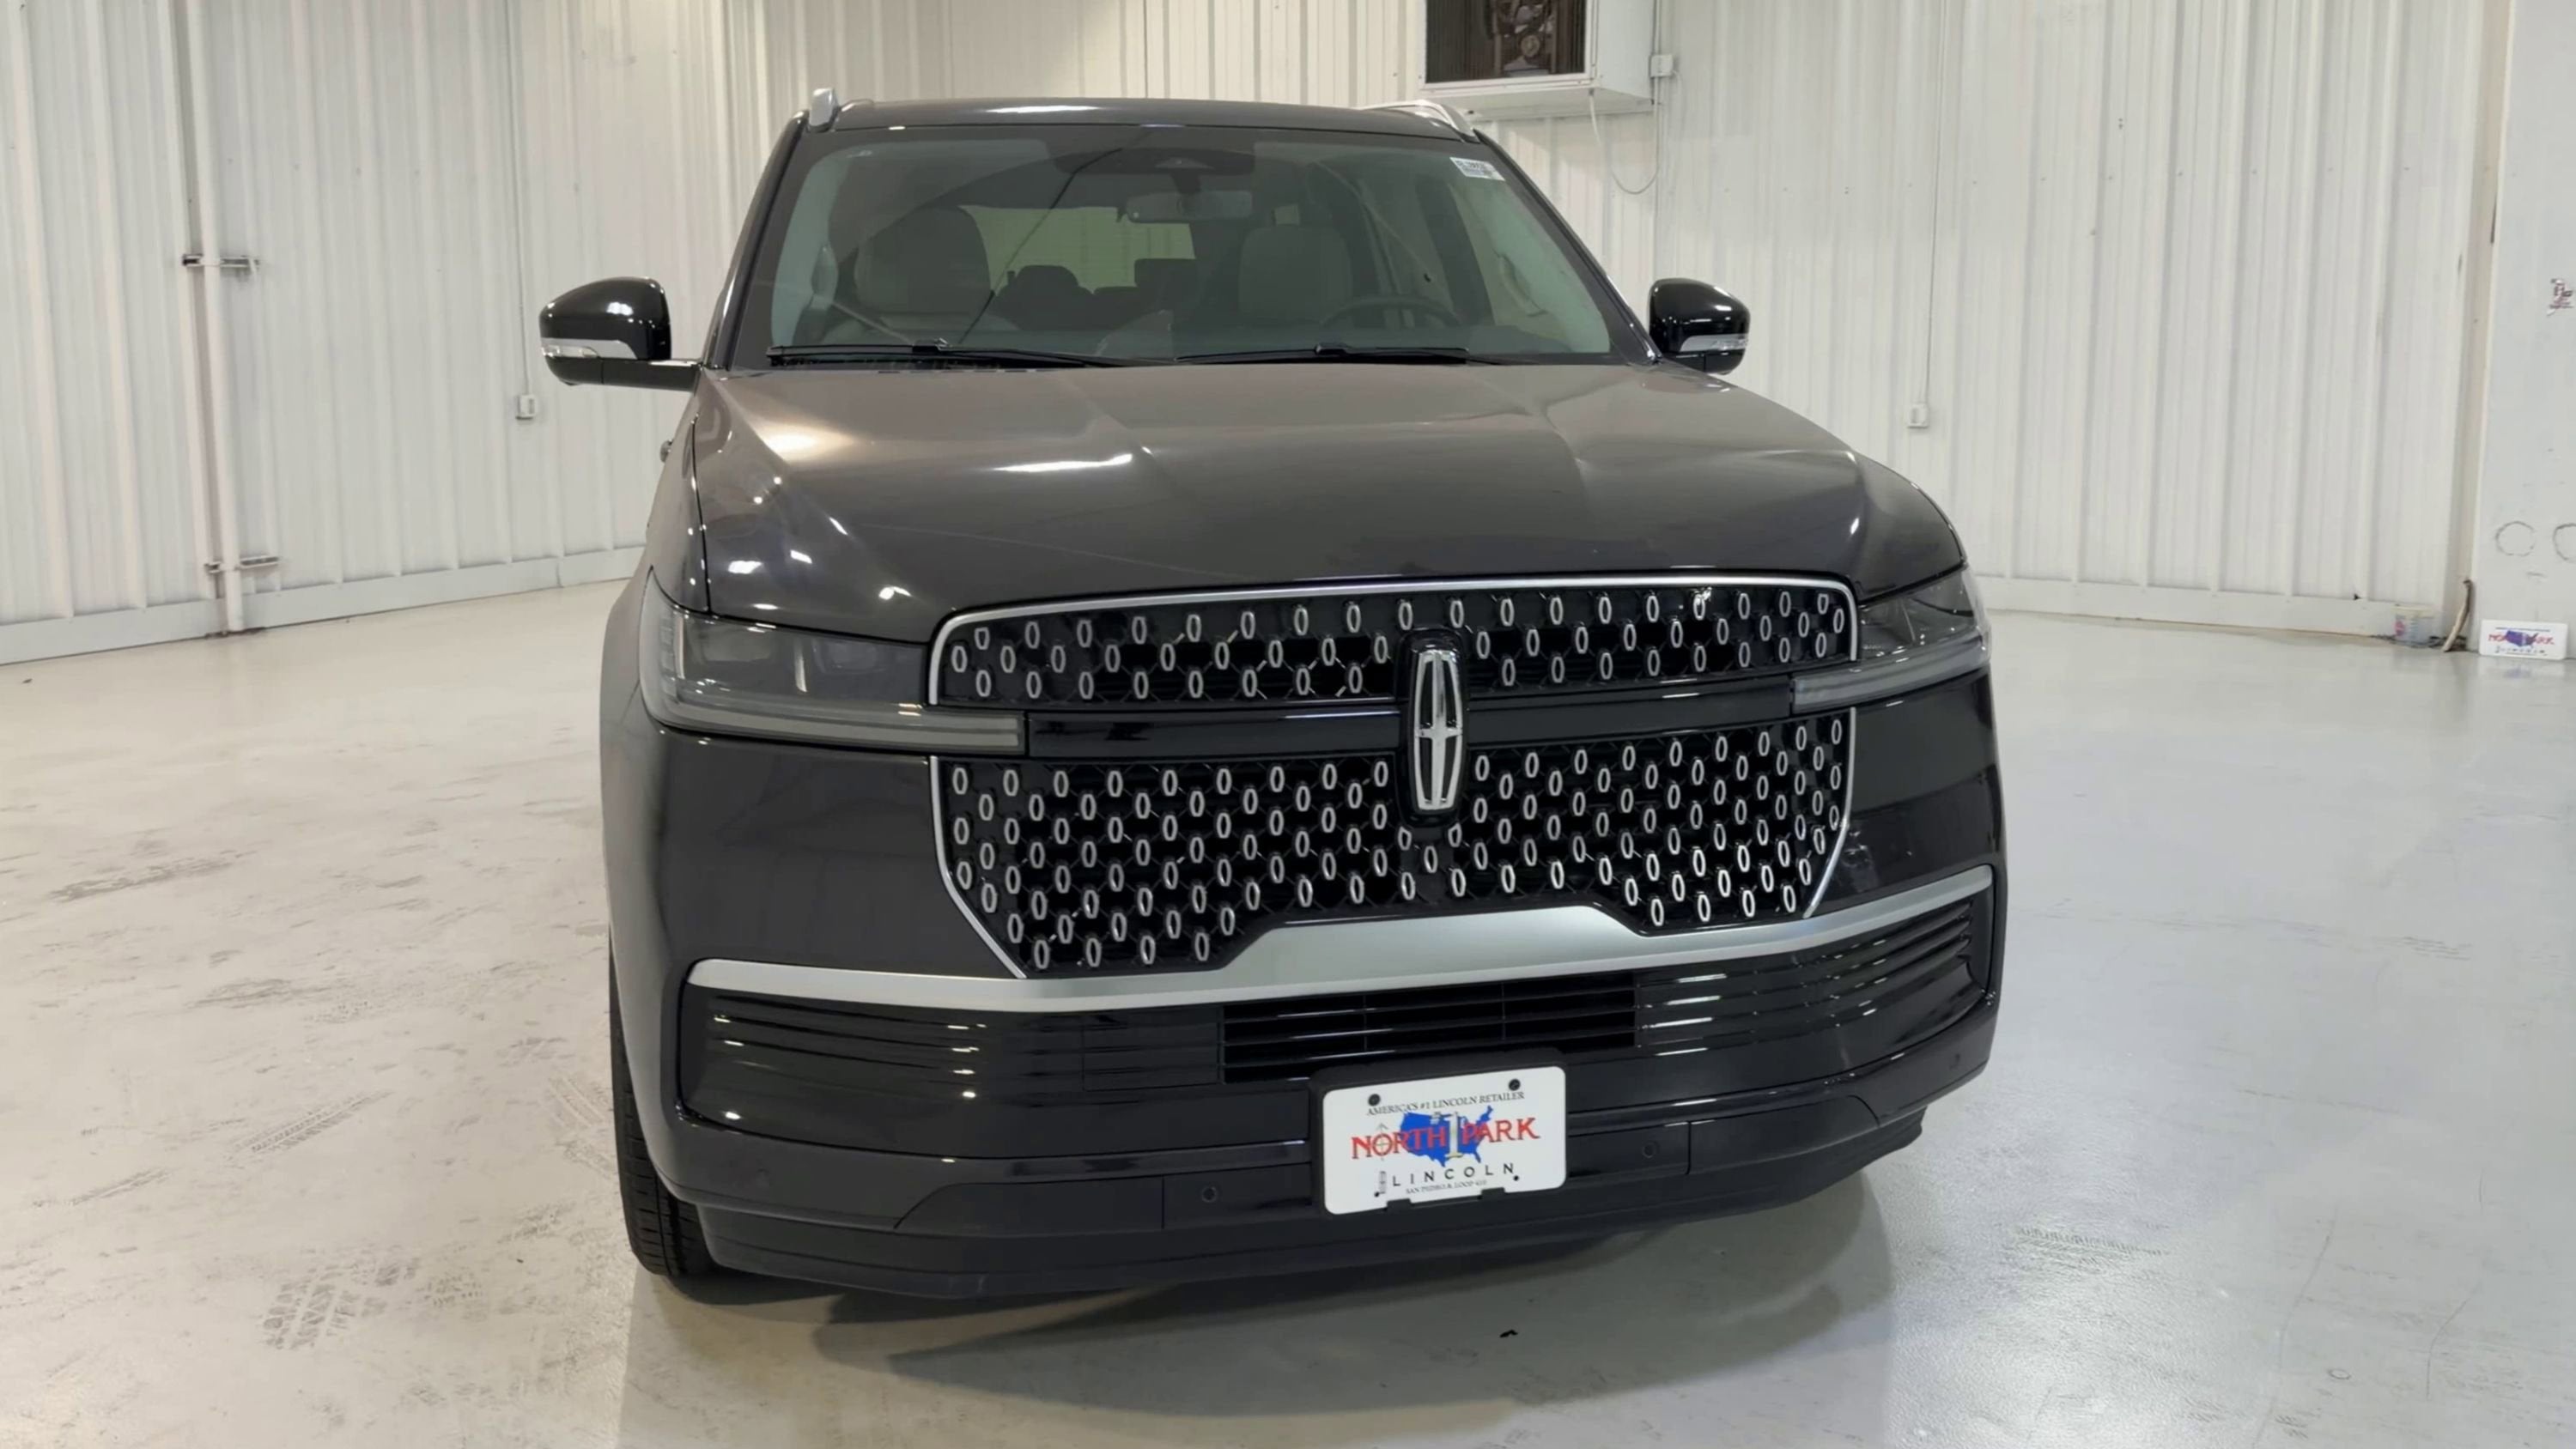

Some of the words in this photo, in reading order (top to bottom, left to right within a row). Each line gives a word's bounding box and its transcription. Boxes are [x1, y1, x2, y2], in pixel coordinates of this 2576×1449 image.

[1432, 1096, 1477, 1109] LINCOLN
[1479, 1091, 1525, 1105] RETAILER
[1351, 1125, 1447, 1160] NORTH
[1461, 1117, 1540, 1145] PARK
[1392, 1162, 1514, 1187] LINCOLN
